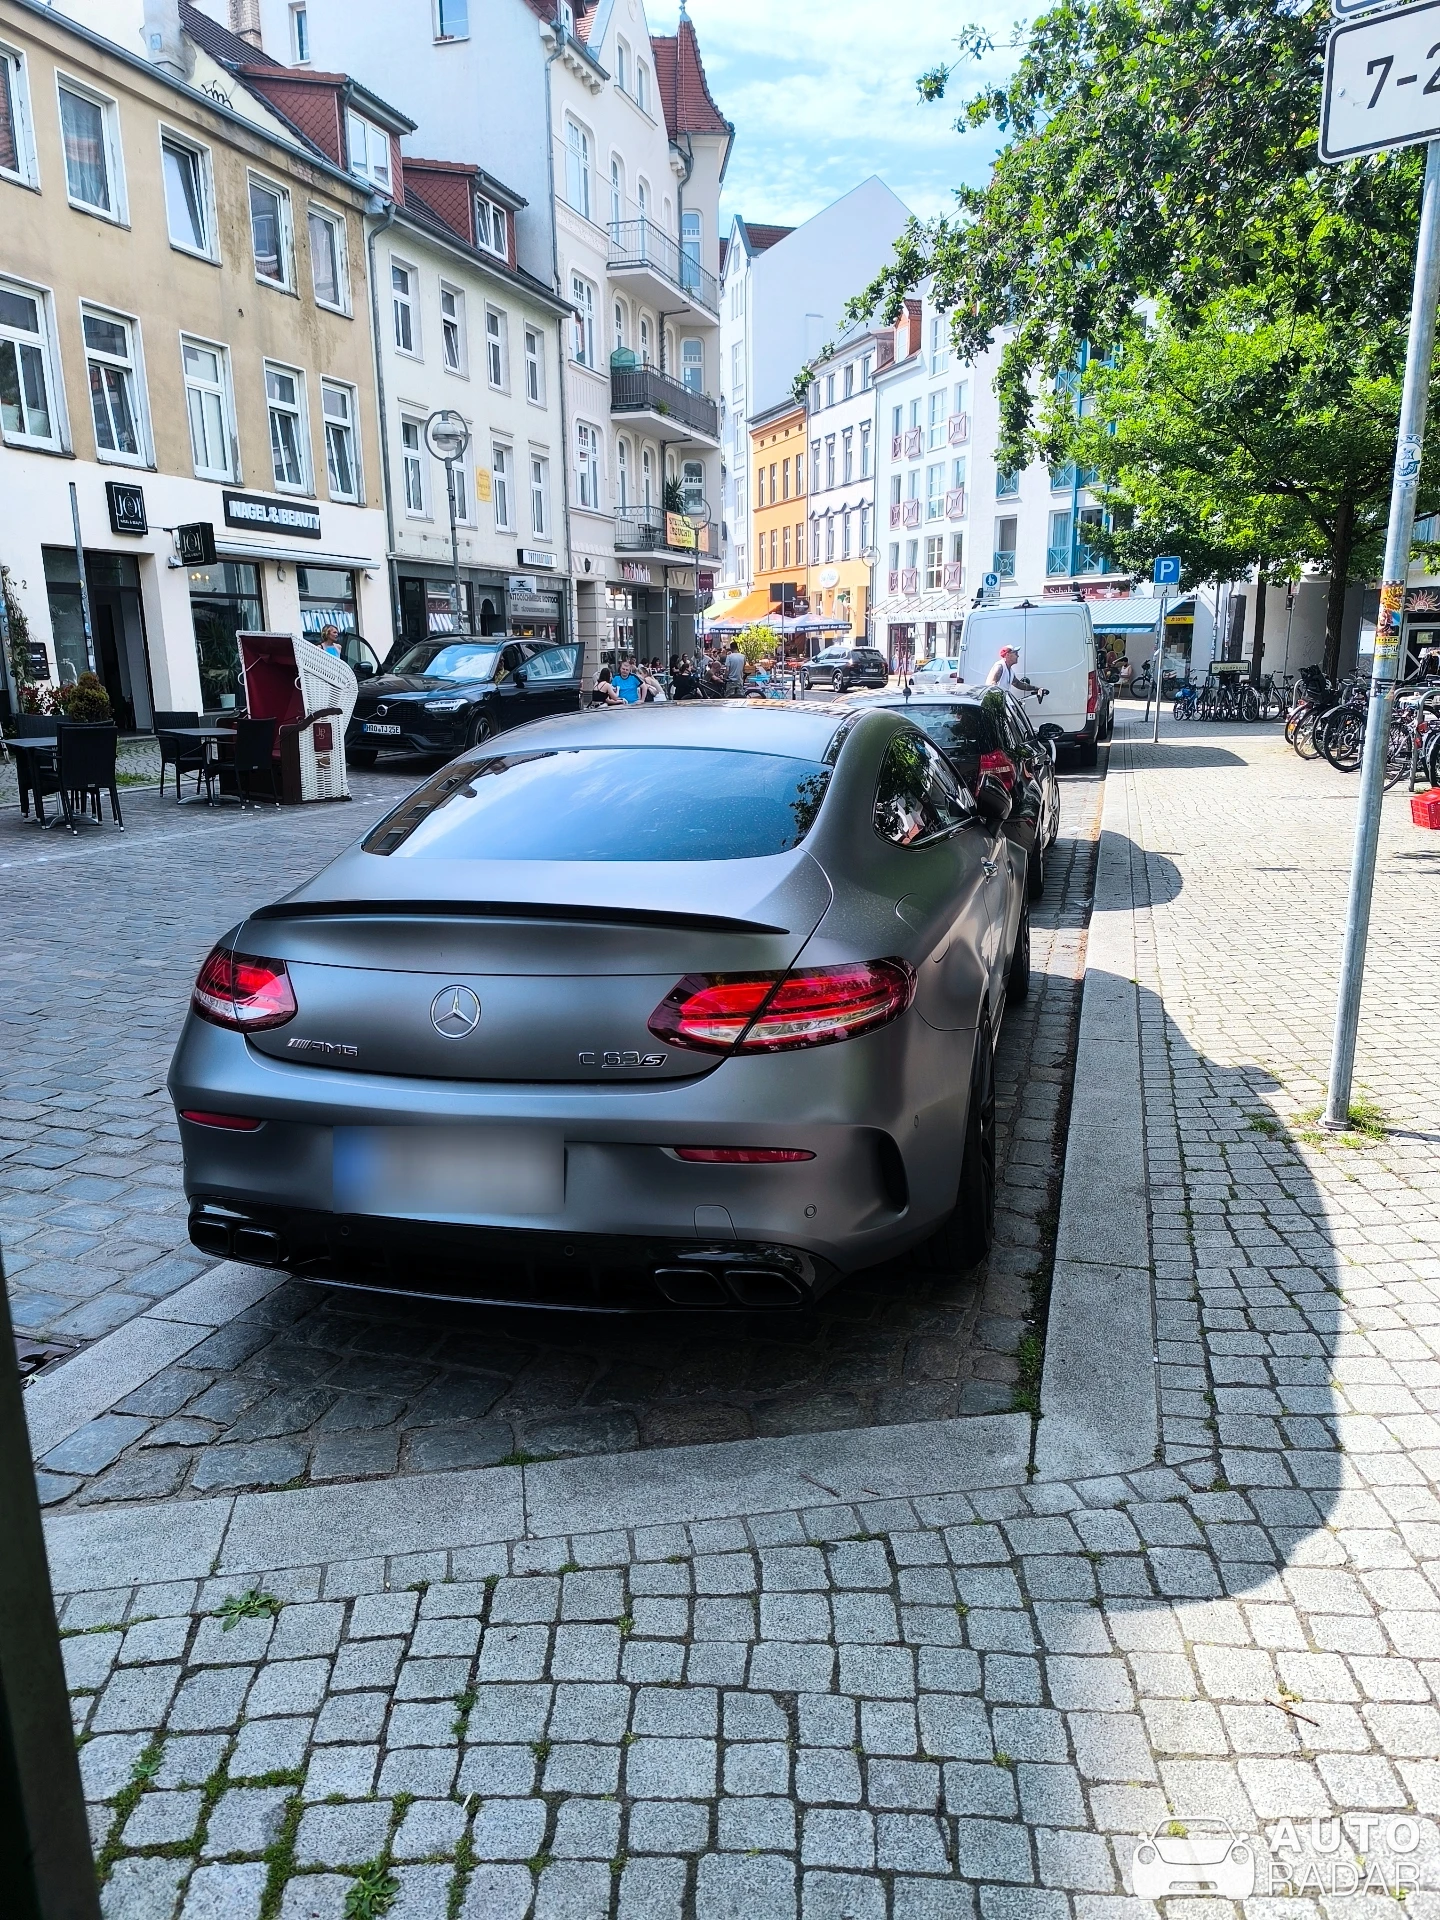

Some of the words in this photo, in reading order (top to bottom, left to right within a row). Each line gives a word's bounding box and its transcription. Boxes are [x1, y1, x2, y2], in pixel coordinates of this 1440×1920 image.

[116, 494, 142, 518] JOY
[229, 500, 269, 522] NAGEL
[269, 507, 280, 524] &
[278, 508, 320, 530] BEAUTY
[1160, 561, 1174, 581] P
[22, 580, 27, 589] 2
[309, 1040, 358, 1057] AMG
[578, 1051, 595, 1065] C
